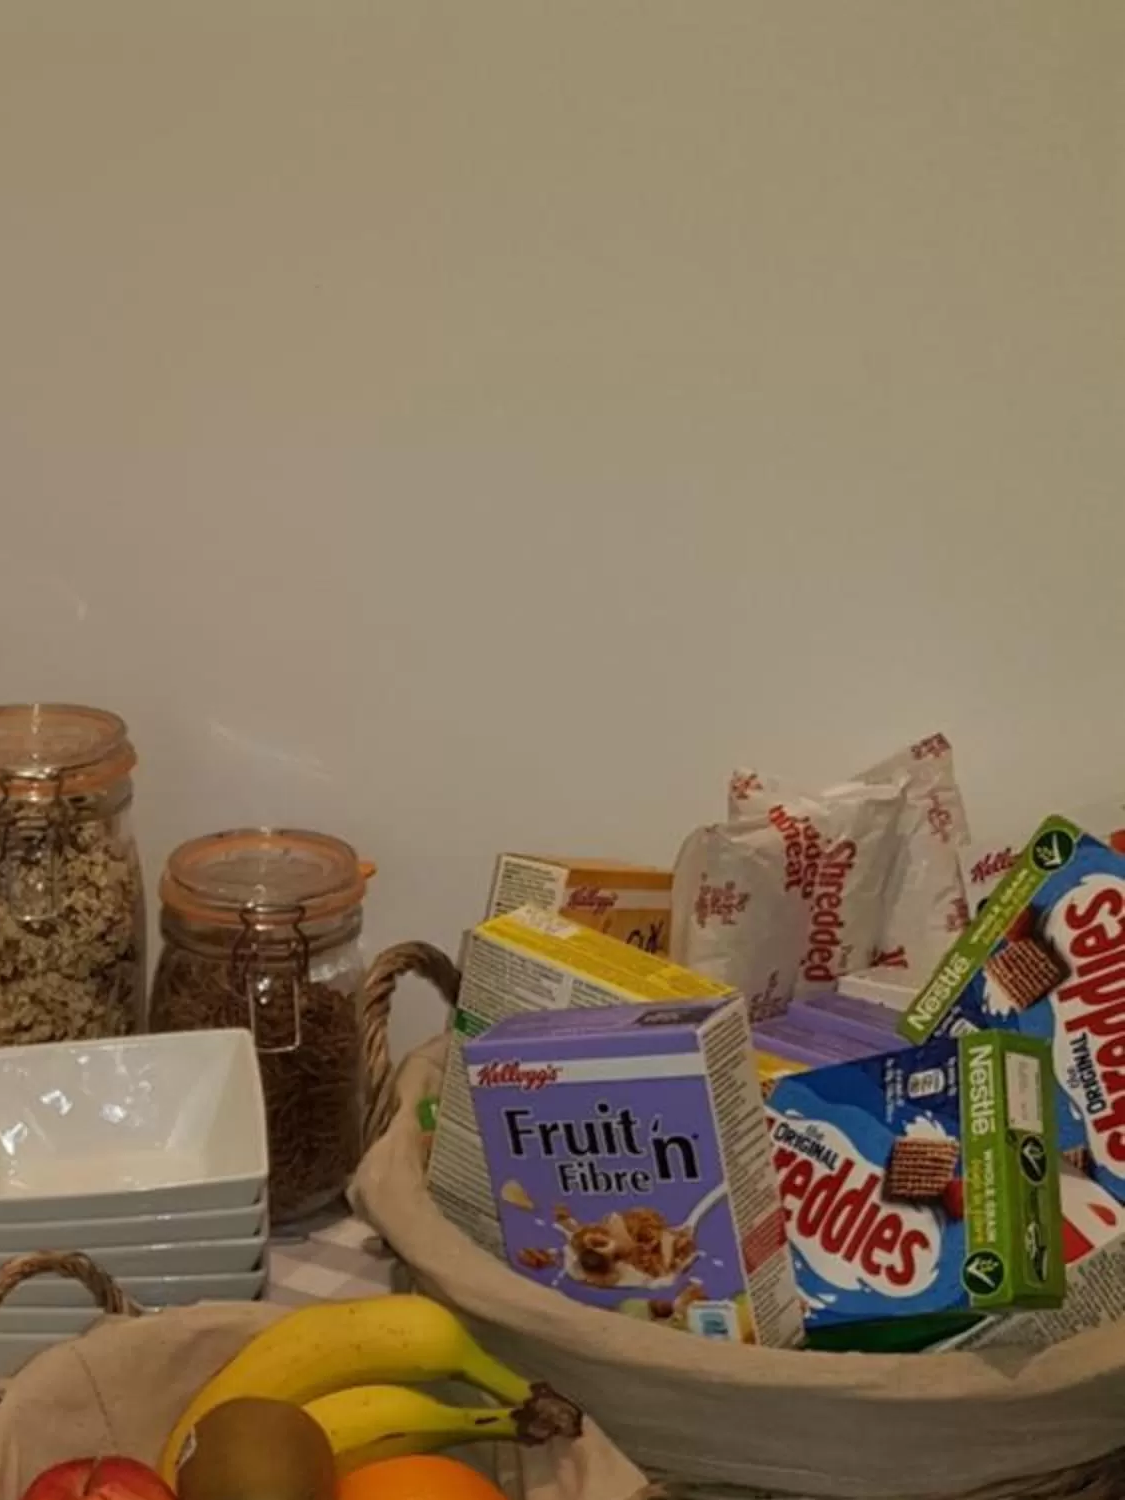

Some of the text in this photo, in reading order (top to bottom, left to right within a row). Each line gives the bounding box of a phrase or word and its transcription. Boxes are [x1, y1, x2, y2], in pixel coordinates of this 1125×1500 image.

[804, 839, 857, 982] Shredded
[477, 1061, 561, 1090] Kellogg's
[1069, 1031, 1107, 1115] ORIGINAL
[503, 1103, 642, 1158] Fruit
[773, 1121, 839, 1171] ORIGINAL
[556, 1163, 651, 1195] Fibre
